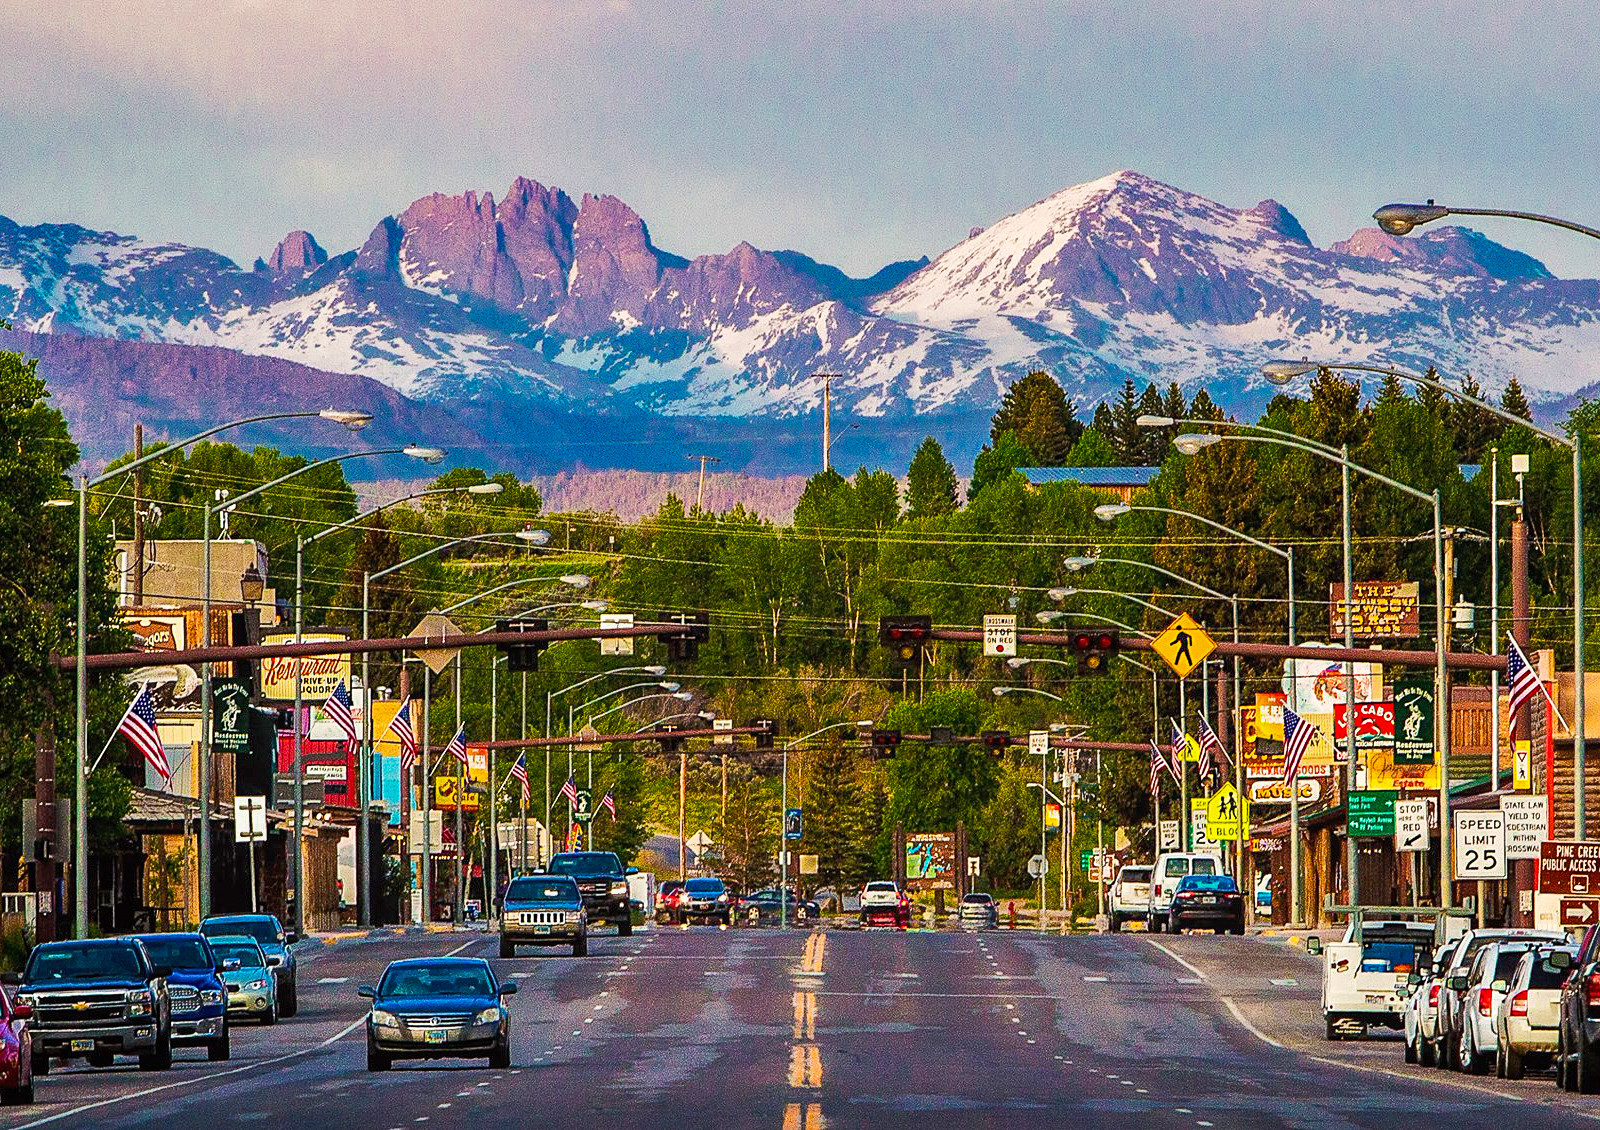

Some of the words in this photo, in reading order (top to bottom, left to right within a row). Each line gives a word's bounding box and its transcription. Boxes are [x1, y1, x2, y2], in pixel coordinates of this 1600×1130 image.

[1355, 585, 1395, 597] THE
[1337, 598, 1415, 613] COWBOY
[987, 628, 1012, 636] STOP
[262, 653, 344, 686] Resturant
[1360, 704, 1395, 725] CABO
[1250, 765, 1285, 776] PACKAG
[1297, 765, 1327, 775] GOODS
[1392, 779, 1425, 787] Estate
[1255, 786, 1313, 799] MUSC
[1399, 805, 1423, 814] STOP
[1504, 801, 1526, 810] STATE
[1528, 801, 1544, 809] LAW
[1508, 812, 1529, 820] YIELD
[1531, 812, 1541, 820] TO
[1402, 823, 1421, 832] RED
[1459, 819, 1502, 830] SPEED
[1208, 827, 1213, 836] 1
[1464, 835, 1497, 845] LIMIT
[1512, 834, 1537, 842] WITHIN
[1507, 845, 1540, 853] ROSSWA
[1556, 845, 1575, 858] PINE
[1577, 845, 1600, 859] CREE
[1465, 849, 1497, 870] 25
[1541, 858, 1567, 871] PUBLIC
[1568, 858, 1597, 873] ACCESS
